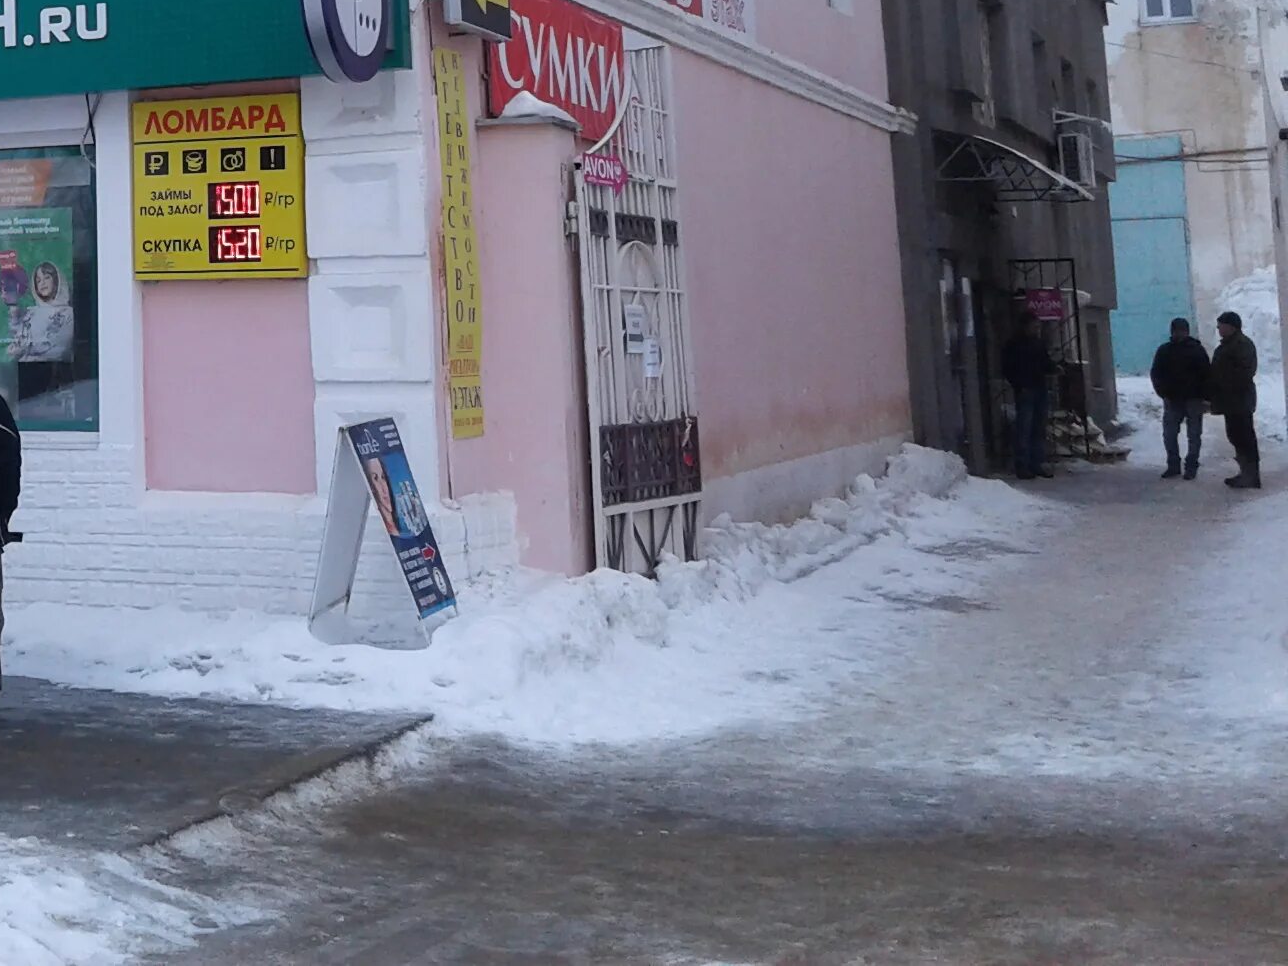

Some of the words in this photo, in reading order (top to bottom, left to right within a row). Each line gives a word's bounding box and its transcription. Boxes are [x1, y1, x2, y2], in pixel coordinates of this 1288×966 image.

[497, 10, 624, 118] СУМКИ
[144, 104, 286, 135] ЛОМБАРД
[584, 155, 615, 180] AVON
[150, 188, 192, 202] ЗАЙМЫ
[216, 184, 260, 216] 1500
[140, 206, 165, 217] ПОД
[167, 204, 204, 216] ЗАЛОГ
[142, 238, 202, 253] СКУПКА
[217, 228, 261, 260] 1520
